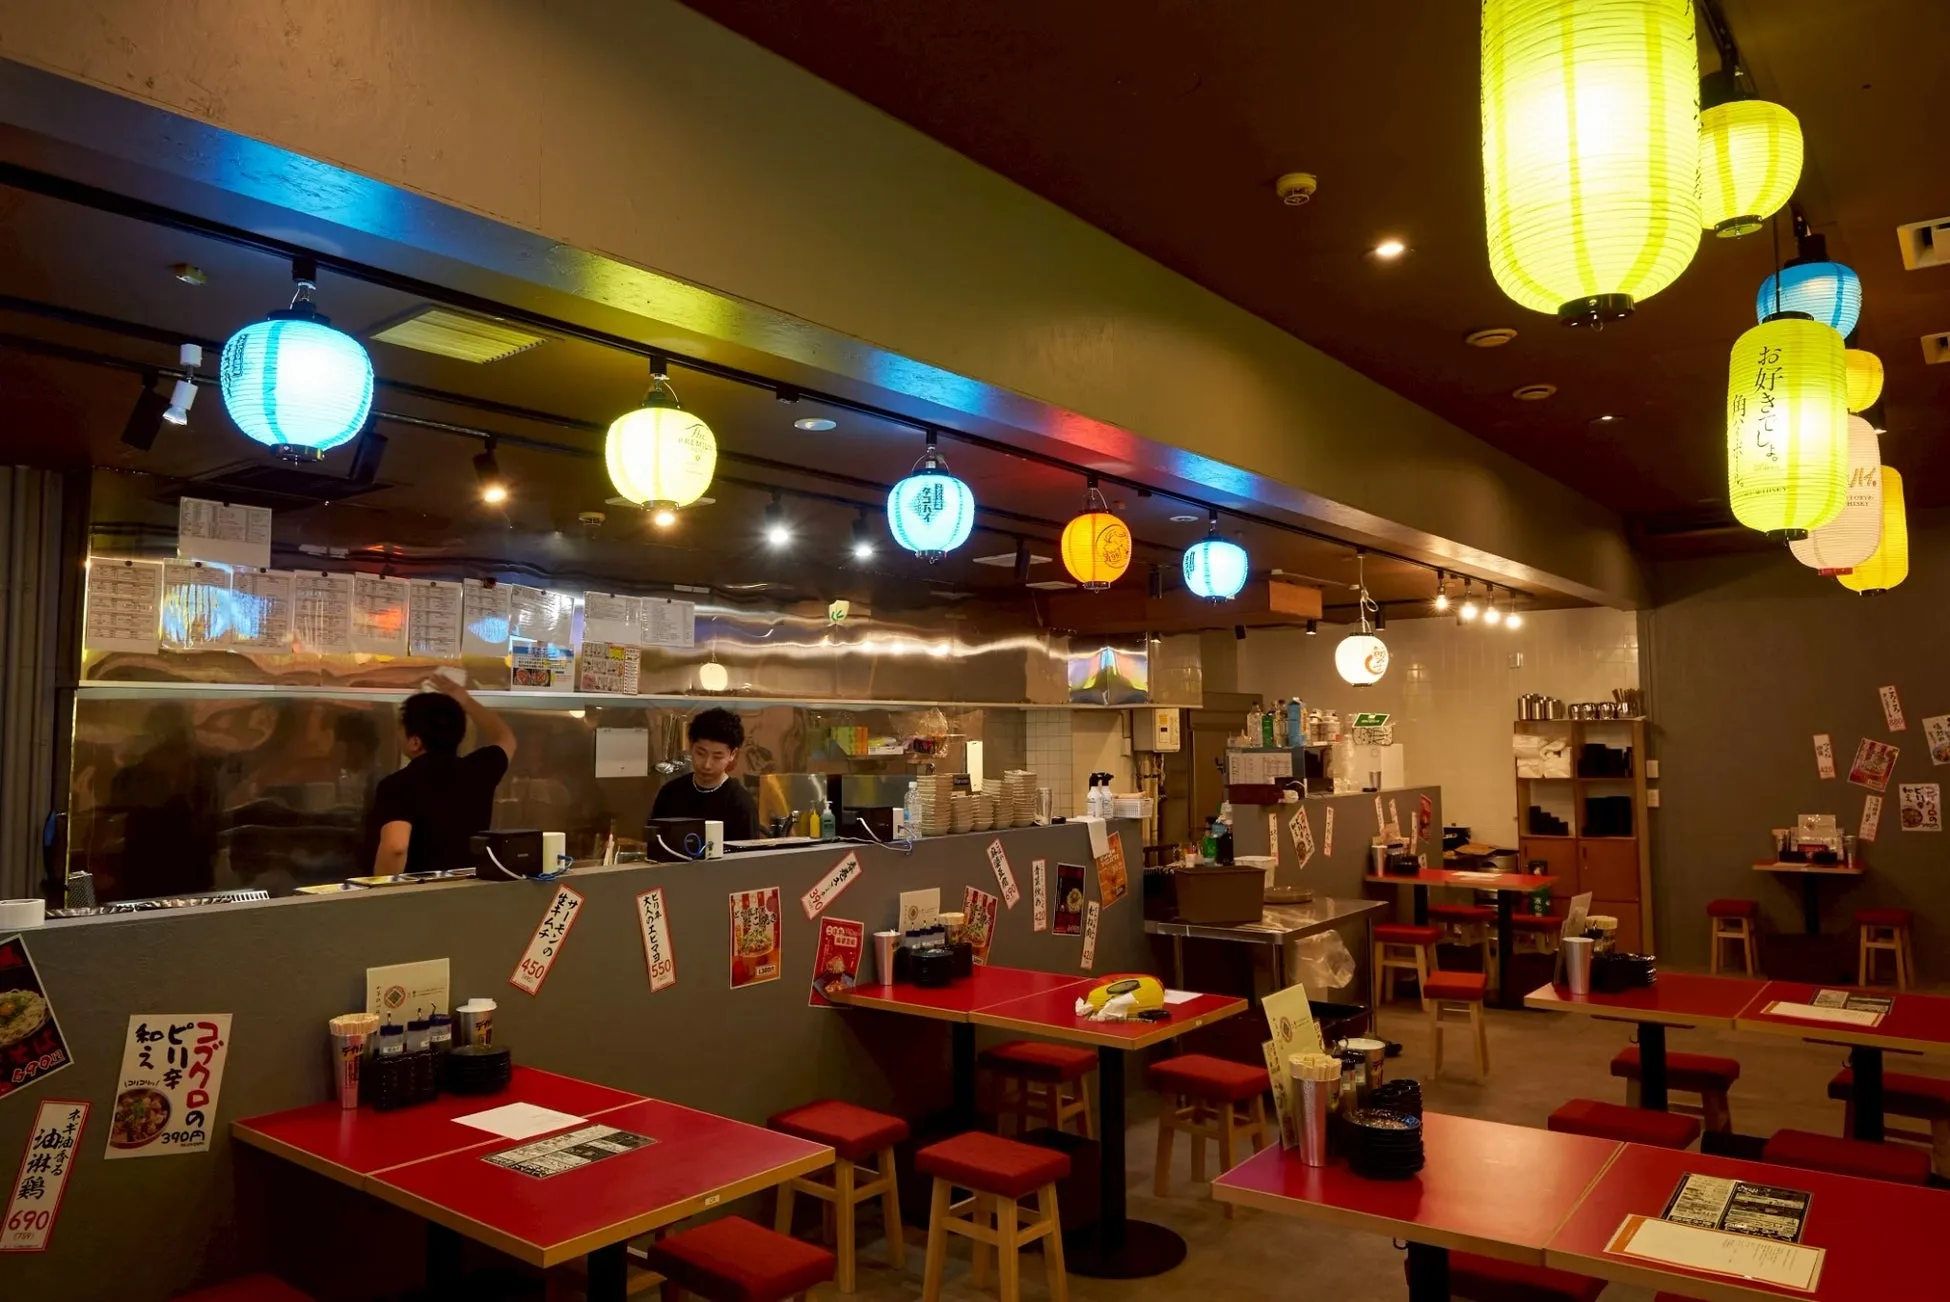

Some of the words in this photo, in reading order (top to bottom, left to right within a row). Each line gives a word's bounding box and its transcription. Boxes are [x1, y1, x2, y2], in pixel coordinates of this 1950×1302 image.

[1755, 346, 1784, 462] お好きでしょ。
[538, 892, 568, 939] 生キムチ
[809, 888, 824, 911] 390
[542, 900, 578, 957] サーモンの
[521, 958, 545, 980] 450
[651, 959, 671, 978] 550
[135, 1023, 164, 1070] 和え
[163, 1022, 194, 1090] ピリ辛
[185, 1022, 224, 1128] コブクロの
[51, 1109, 80, 1176] ネギ油香る
[161, 1130, 205, 1145] 390円
[16, 1128, 61, 1200] 油淋鶏
[8, 1210, 50, 1232] 690
